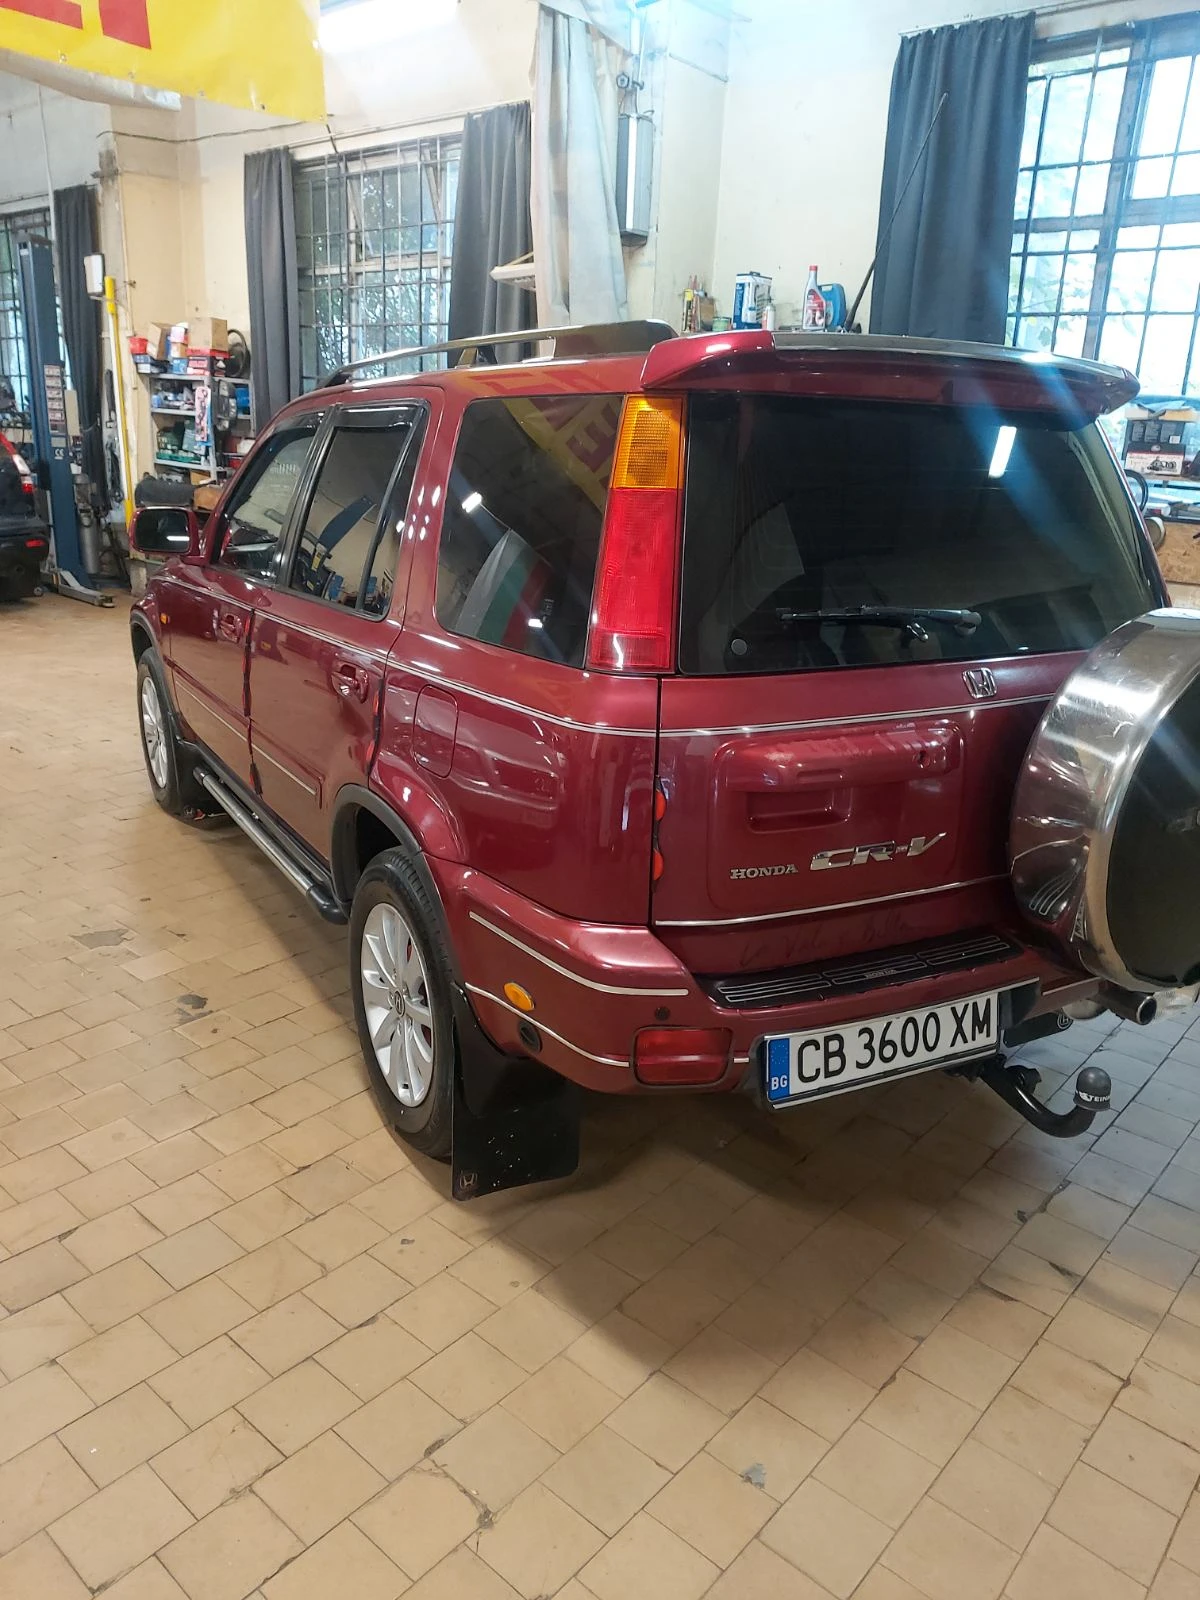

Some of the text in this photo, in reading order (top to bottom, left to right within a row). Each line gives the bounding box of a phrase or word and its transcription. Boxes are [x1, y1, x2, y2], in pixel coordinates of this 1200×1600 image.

[730, 832, 947, 880] HONDA CR-V
[797, 997, 991, 1084] CB 3600 XM
[771, 1075, 788, 1091] BG
